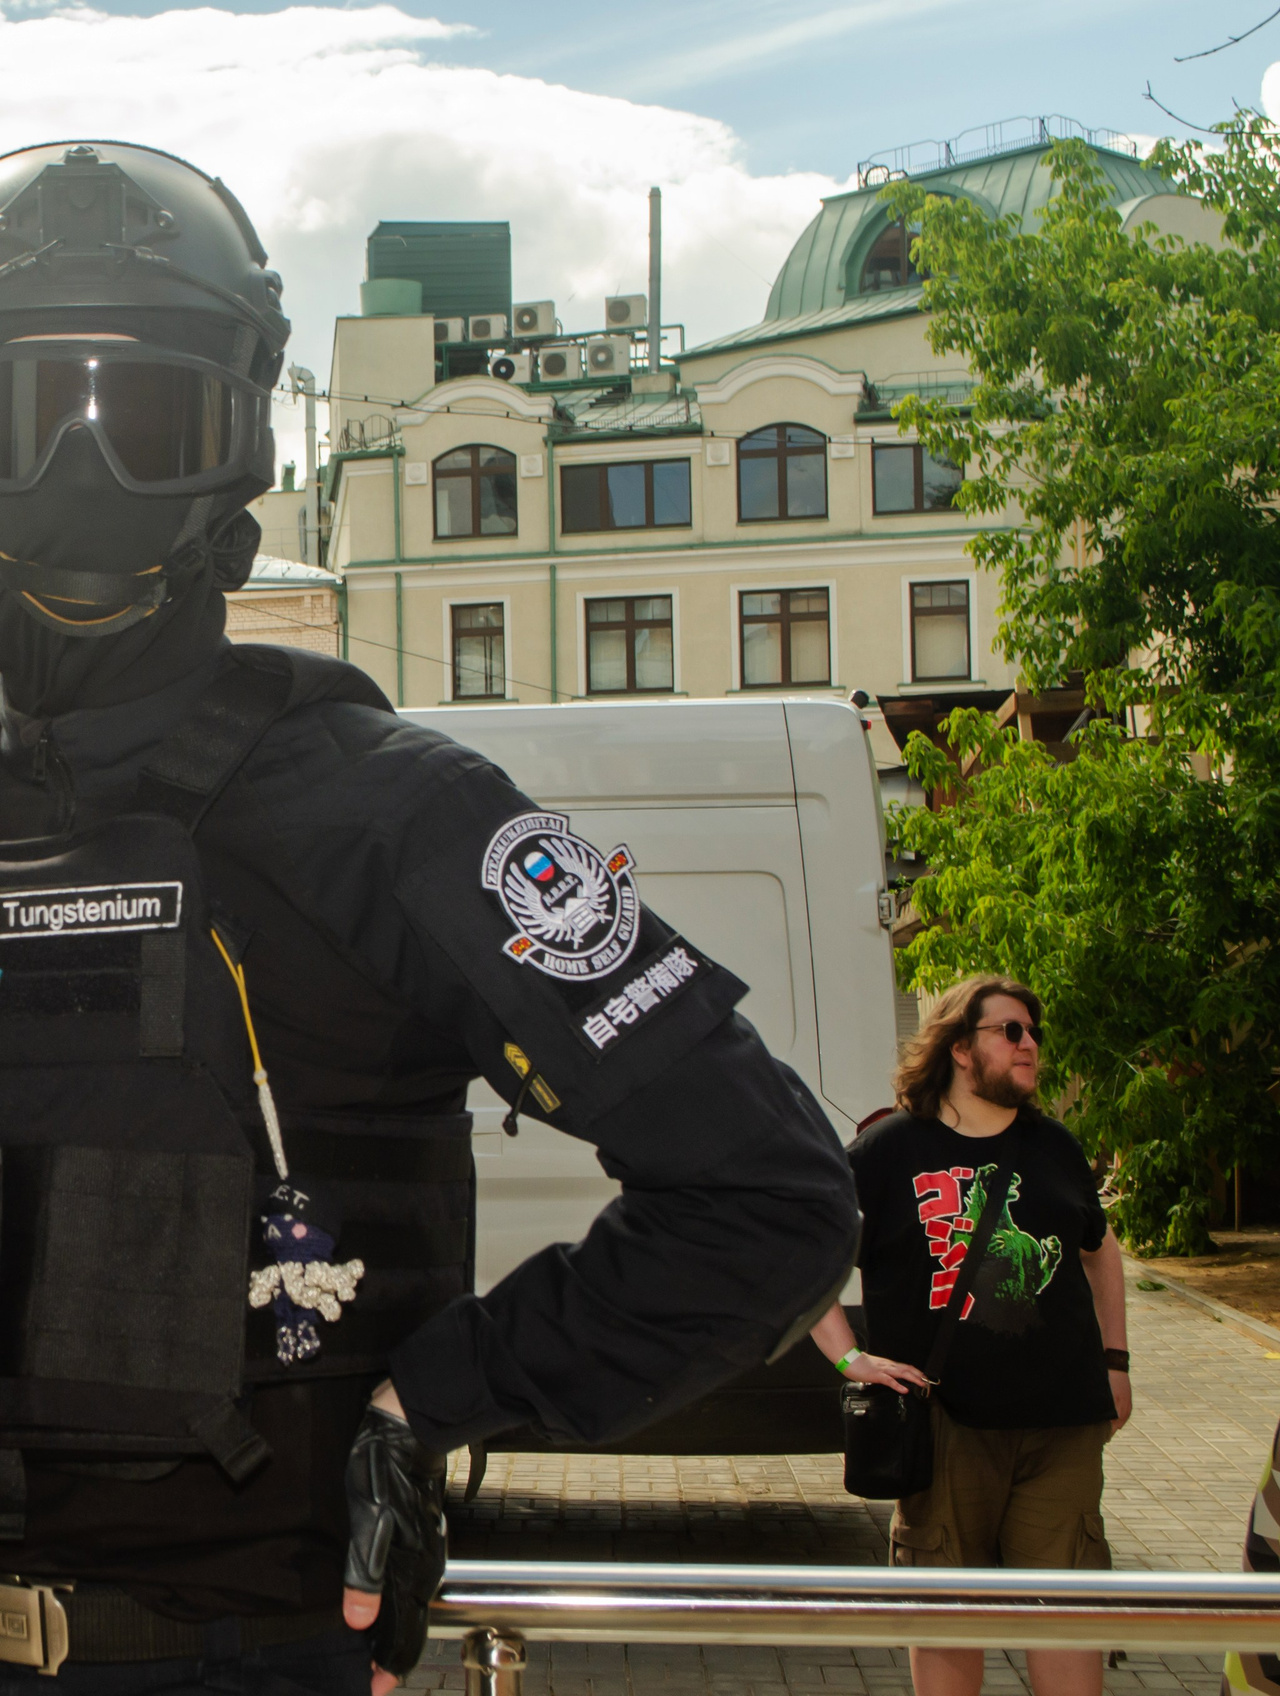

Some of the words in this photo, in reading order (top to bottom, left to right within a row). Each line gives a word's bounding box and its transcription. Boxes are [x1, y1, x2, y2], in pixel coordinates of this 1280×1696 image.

[2, 893, 161, 931] Tungstenium
[543, 952, 590, 974] HOME
[591, 939, 623, 970] SELF
[617, 886, 635, 941] GUARD
[582, 946, 698, 1050] 自宅警備隊
